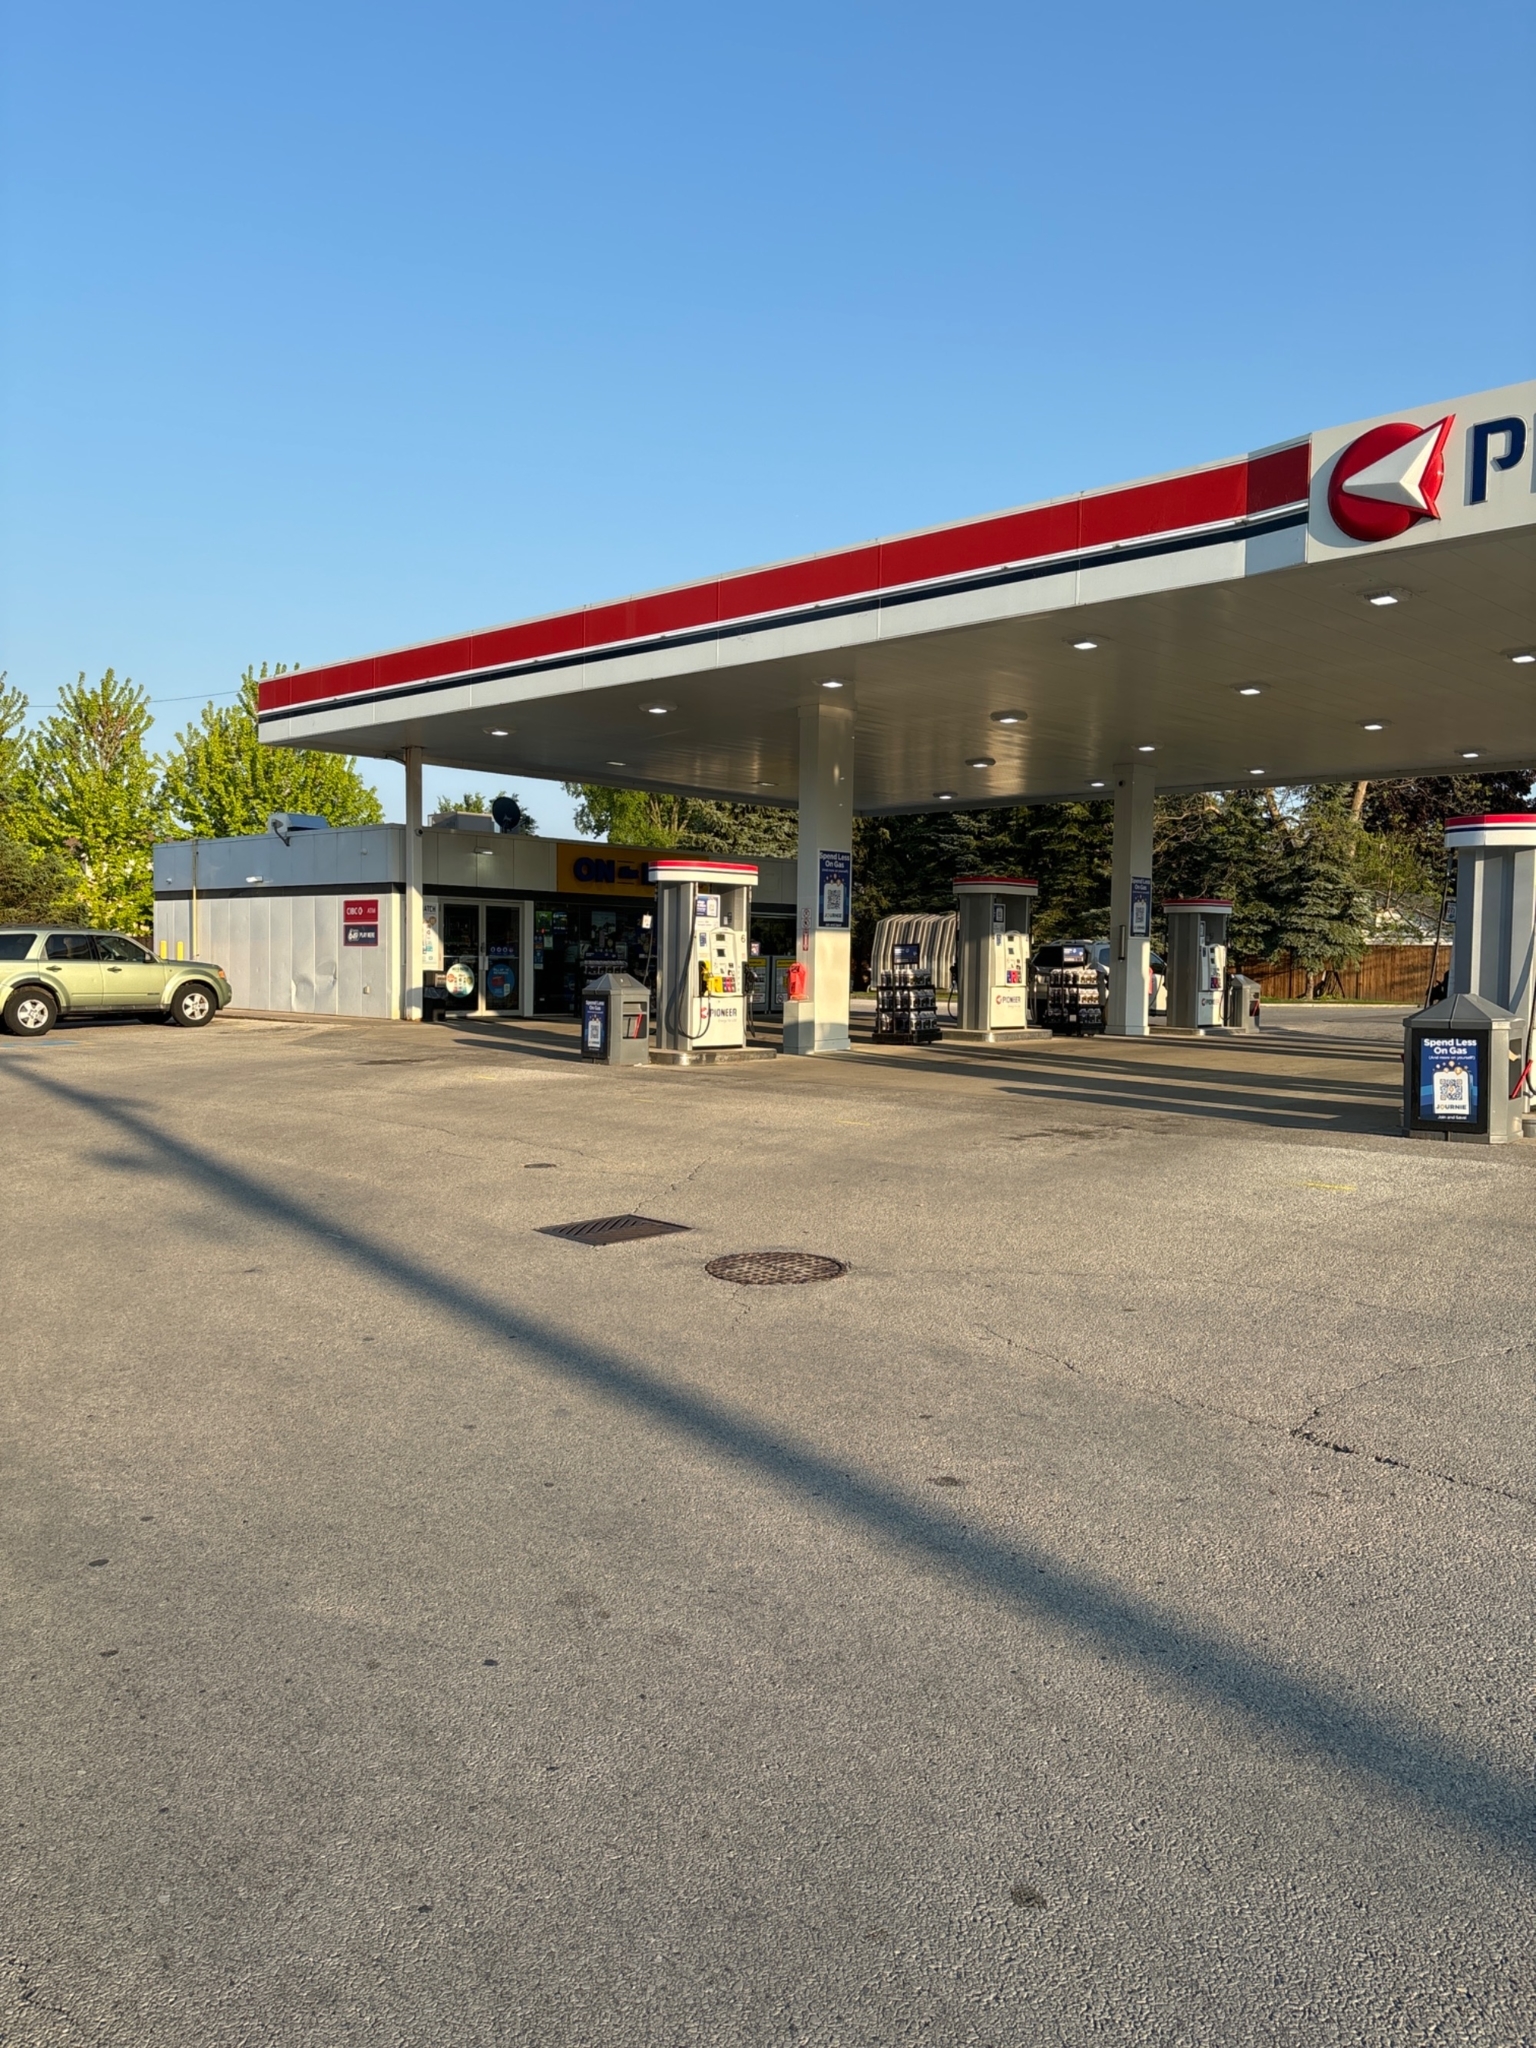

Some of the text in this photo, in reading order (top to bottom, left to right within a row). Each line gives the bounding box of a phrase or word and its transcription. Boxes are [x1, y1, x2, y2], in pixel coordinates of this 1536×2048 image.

[1467, 415, 1536, 506] P
[819, 852, 850, 861] Spend Less
[825, 860, 844, 869] On Gas
[573, 857, 615, 883] ON
[740, 934, 746, 943] 6
[710, 1008, 737, 1017] PIONEER
[1424, 1038, 1477, 1048] Spend Less
